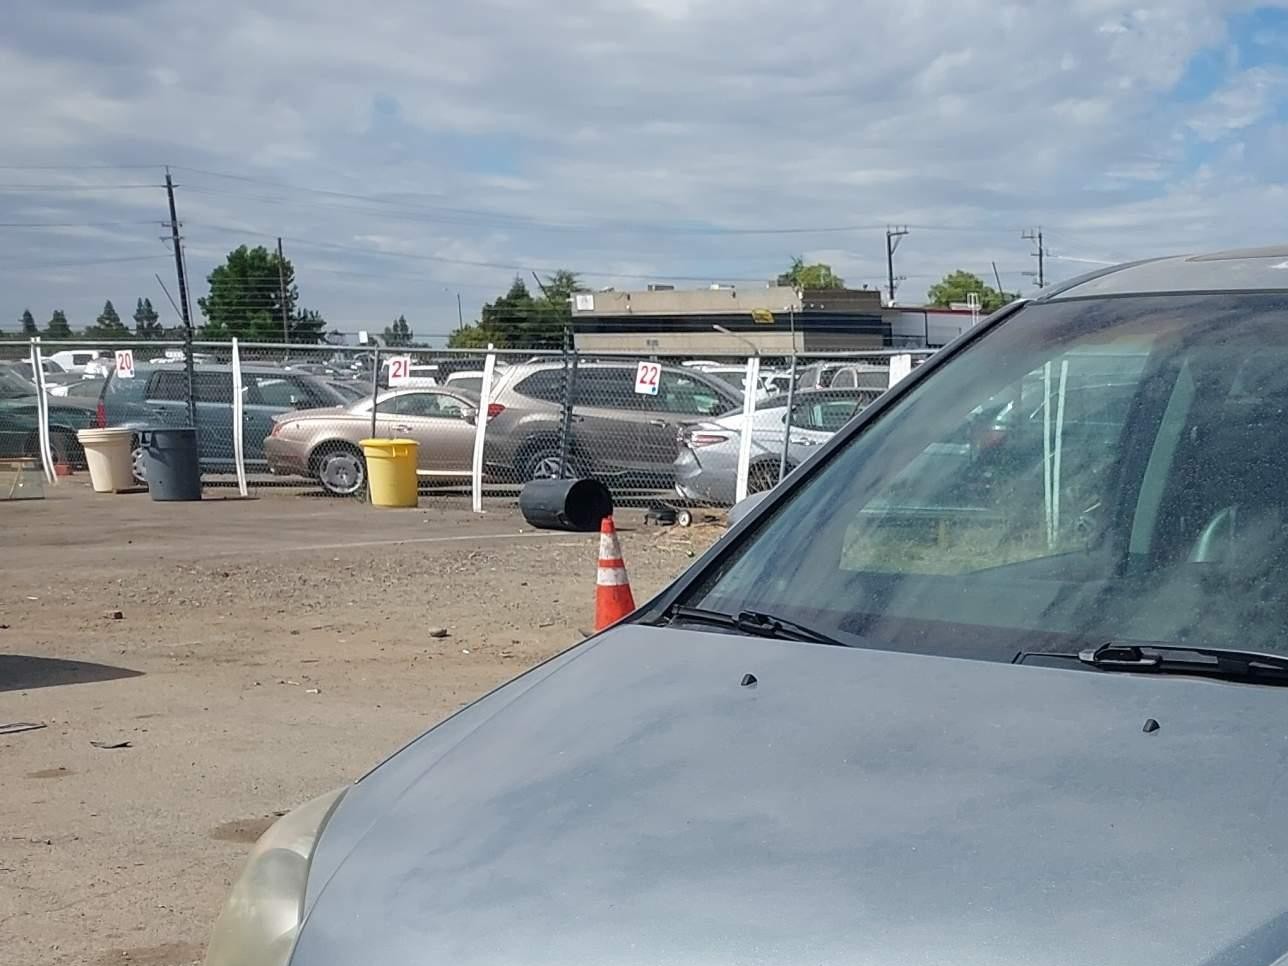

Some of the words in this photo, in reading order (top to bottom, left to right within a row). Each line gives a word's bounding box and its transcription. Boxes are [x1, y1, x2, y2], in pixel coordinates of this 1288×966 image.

[118, 352, 131, 370] 20
[392, 360, 407, 378] 21
[639, 365, 658, 385] 22
